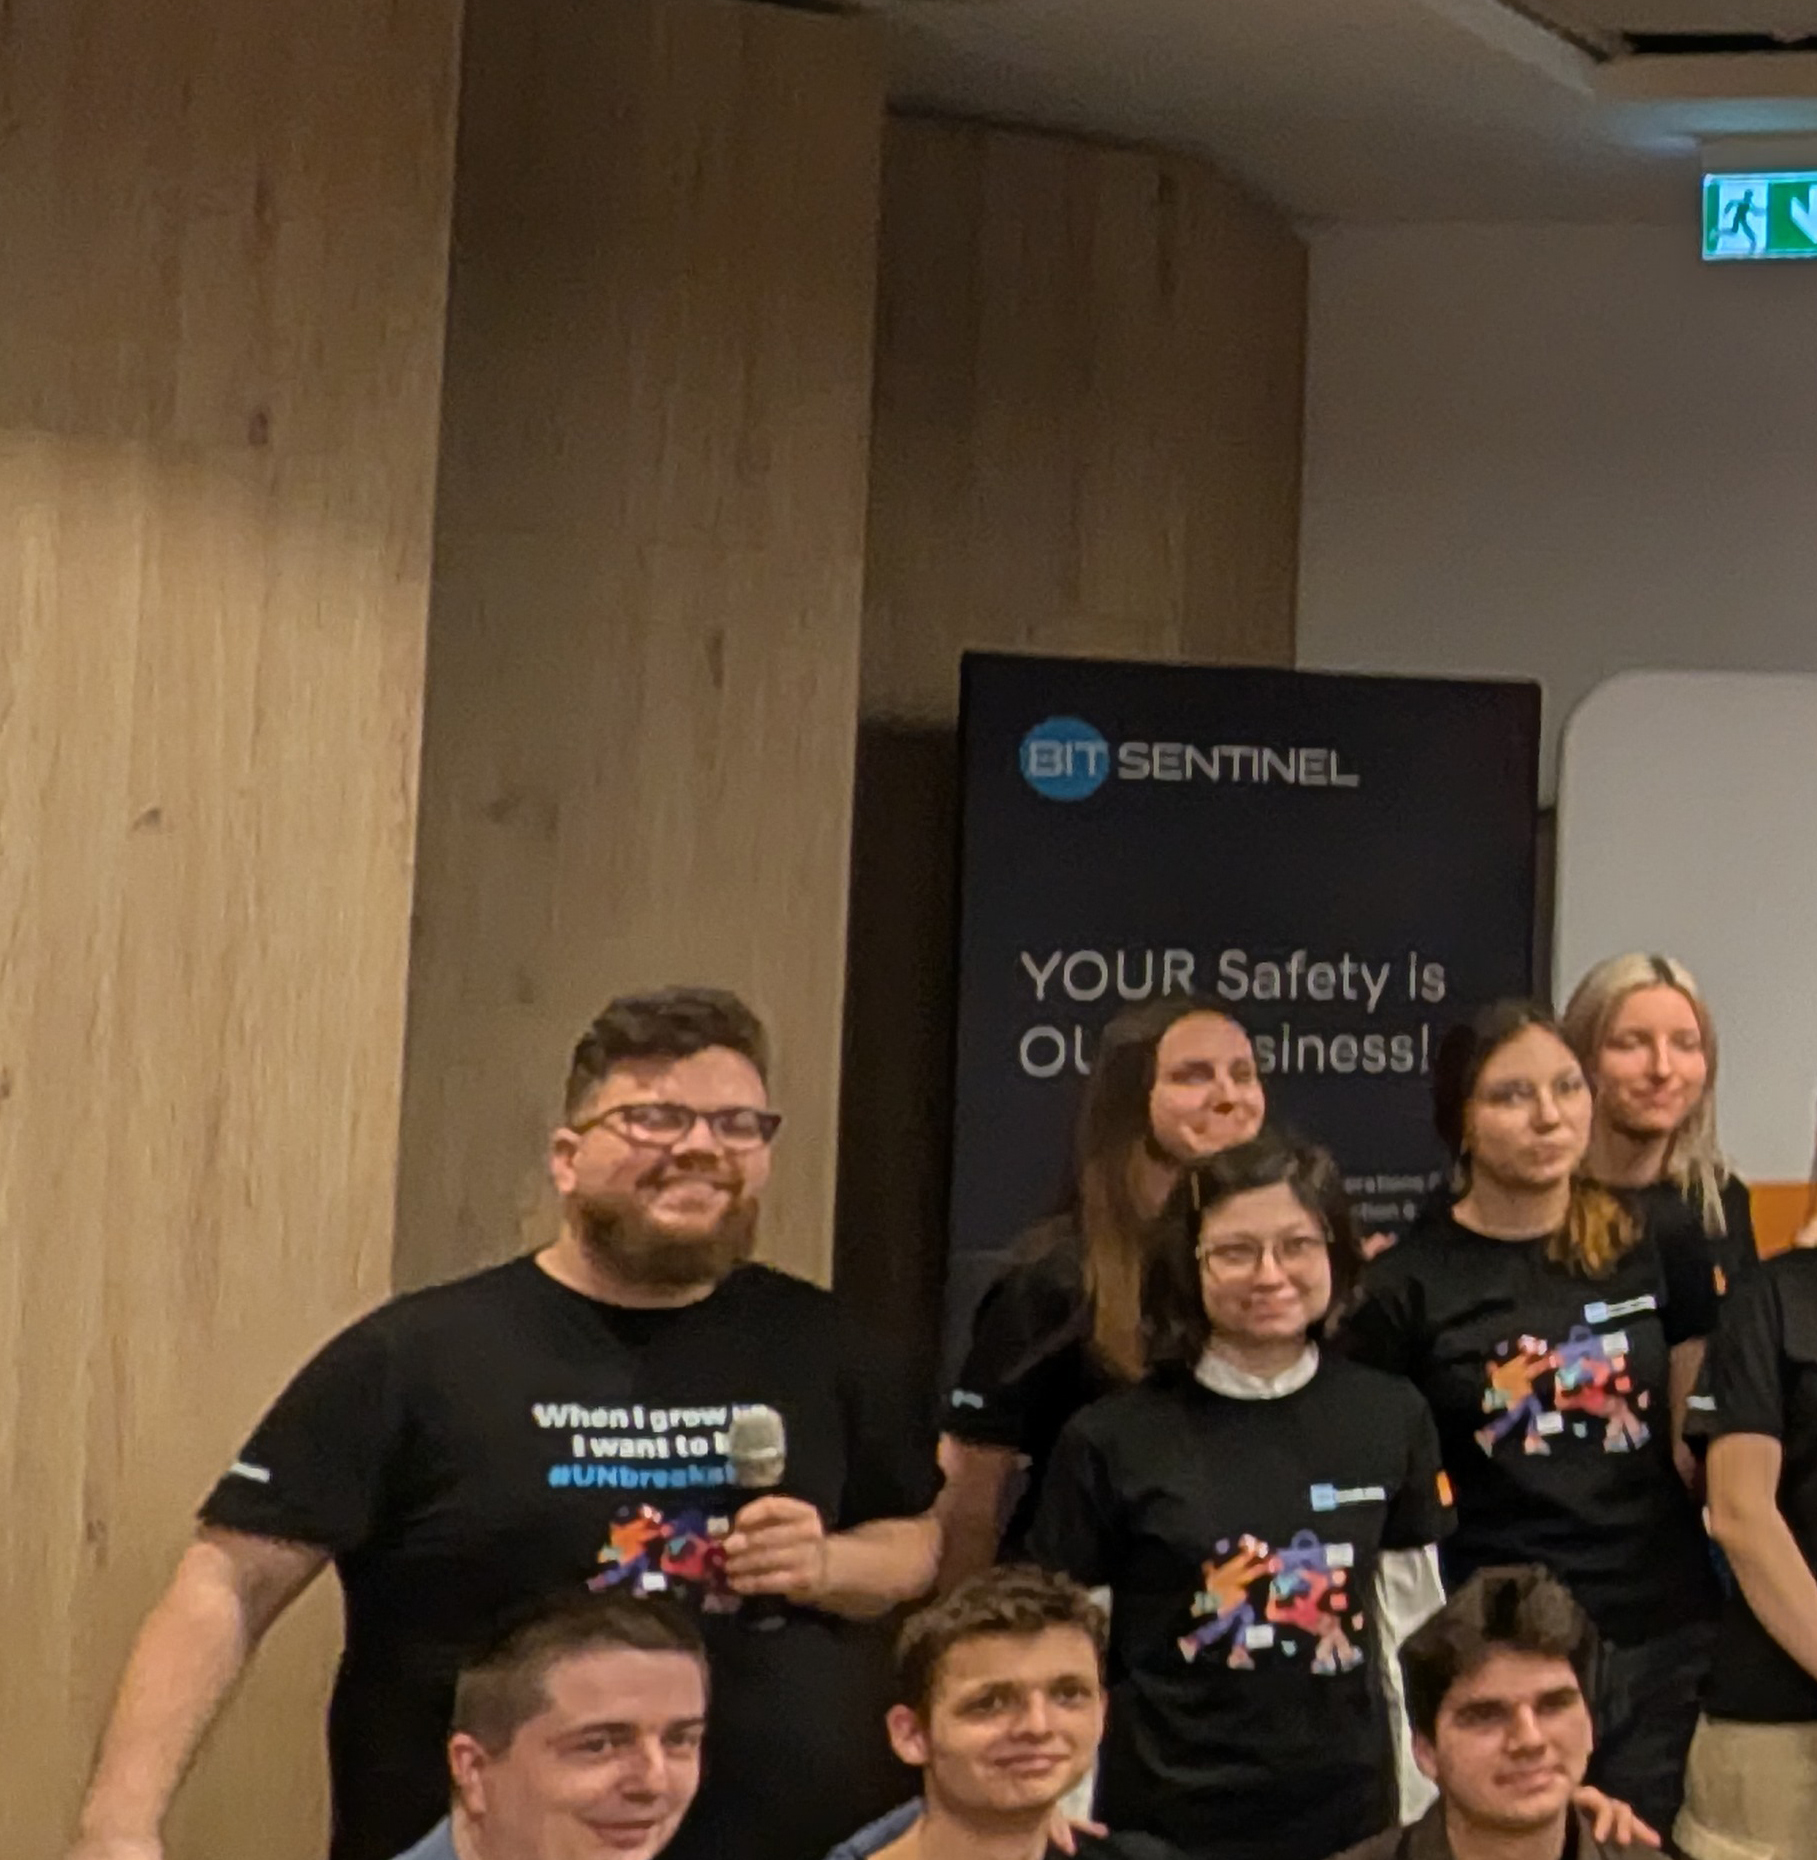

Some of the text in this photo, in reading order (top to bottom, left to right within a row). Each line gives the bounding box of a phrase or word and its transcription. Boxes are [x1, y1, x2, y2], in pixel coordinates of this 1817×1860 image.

[1027, 739, 1360, 788] BIT SENTINEL
[1020, 949, 1447, 1012] YOUR Safety is
[1257, 1023, 1431, 1074] siness!
[531, 1403, 629, 1429] When
[650, 1406, 728, 1432] grow
[589, 1436, 670, 1459] want
[675, 1434, 709, 1458] to
